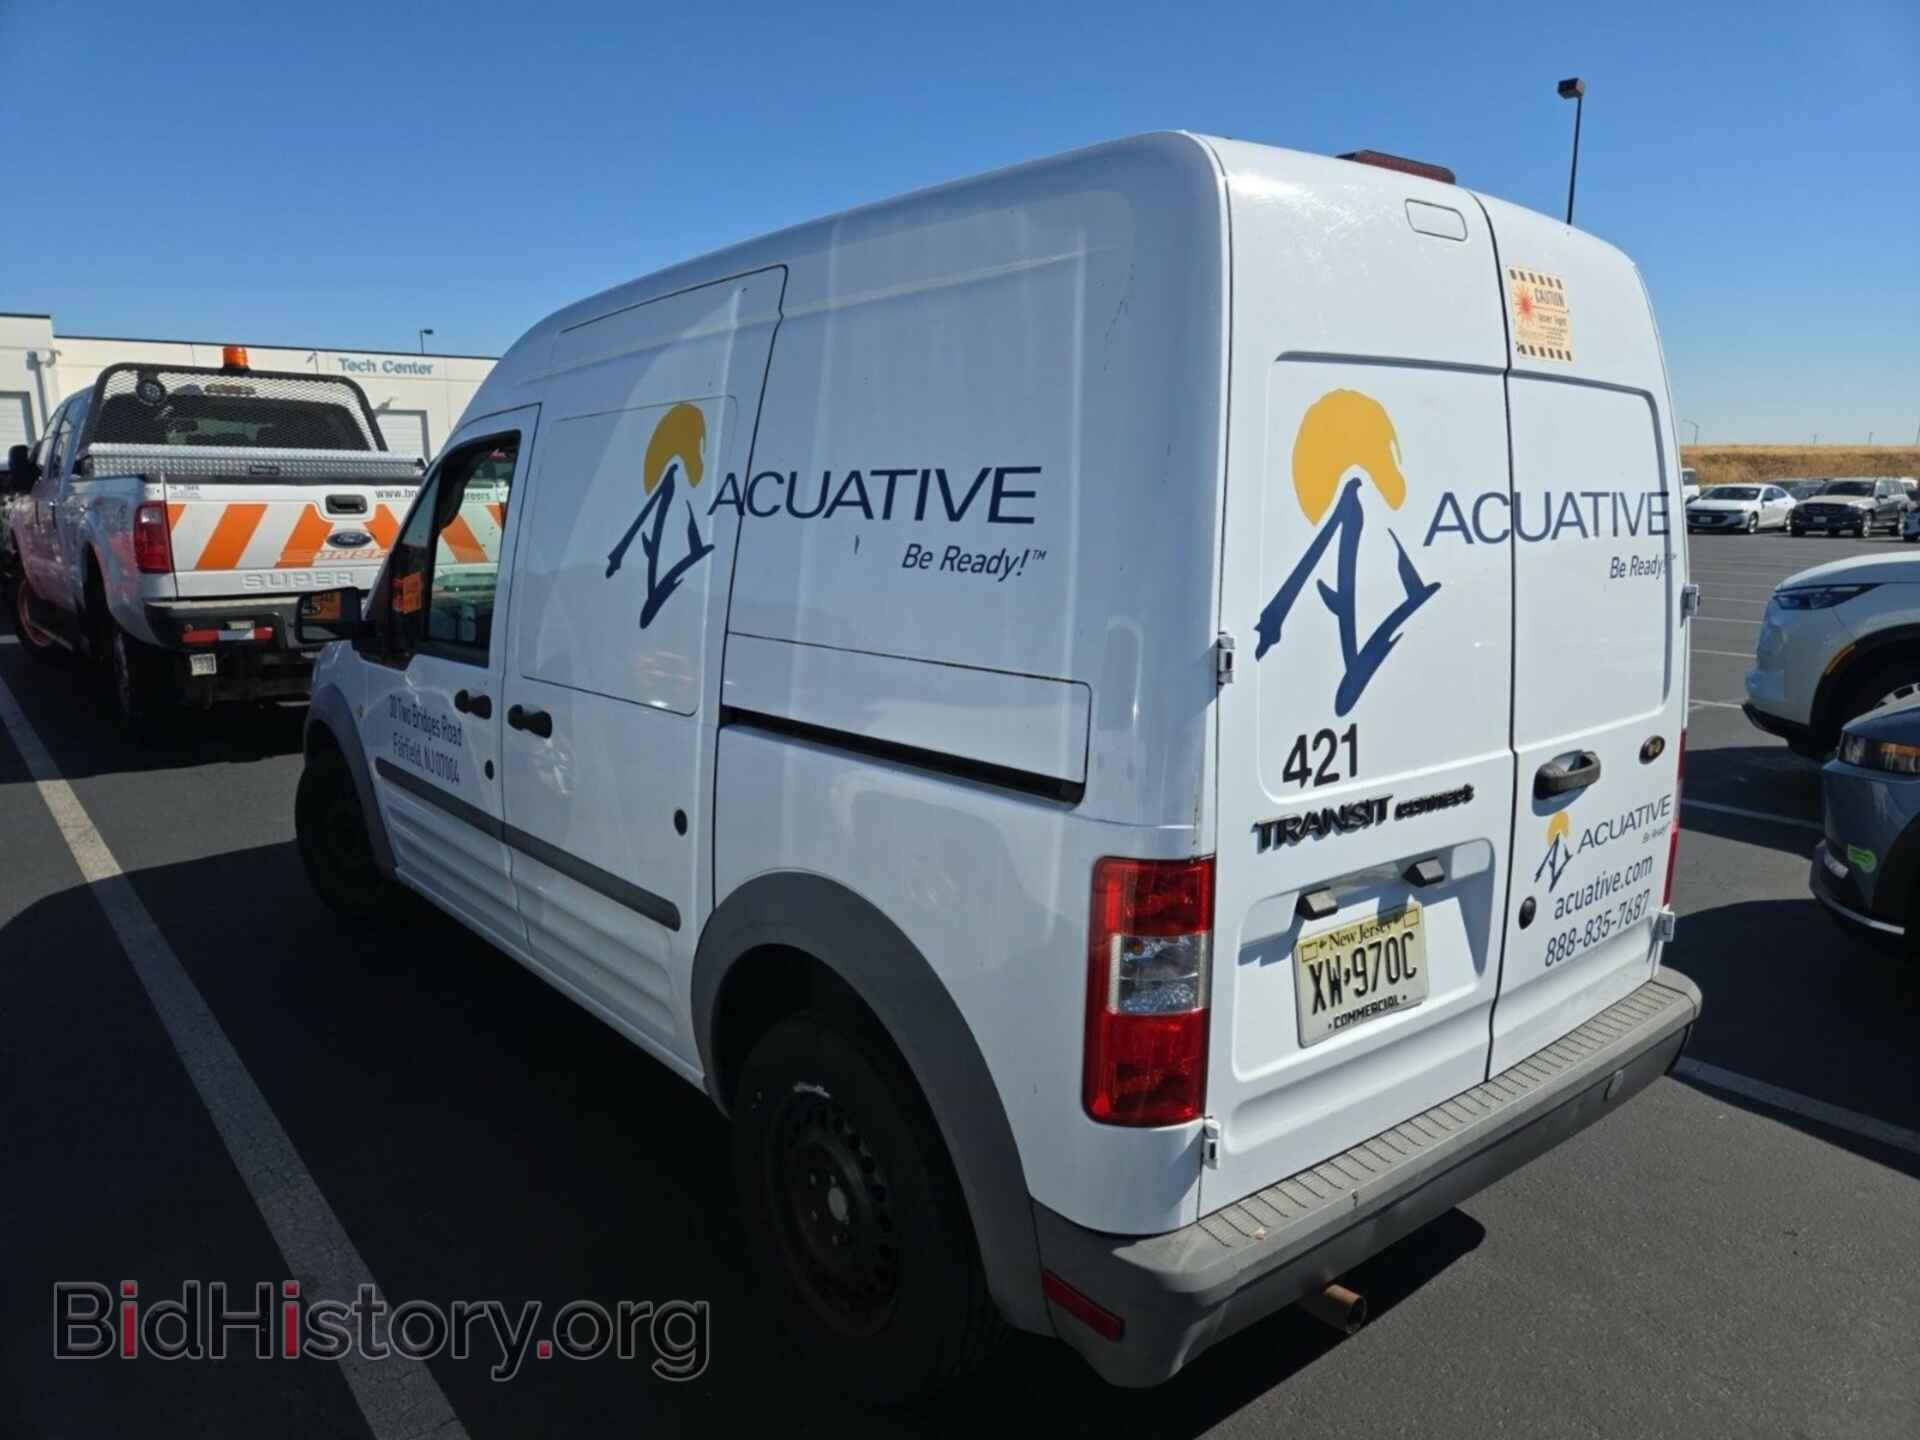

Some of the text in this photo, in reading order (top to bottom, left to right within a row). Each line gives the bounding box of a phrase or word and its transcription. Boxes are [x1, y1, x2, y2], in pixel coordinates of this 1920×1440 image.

[338, 357, 433, 375] Tech Center
[706, 466, 1042, 525] ACUATIVE
[1422, 491, 1670, 547] ACUATIVE
[241, 571, 354, 591] SUPER
[901, 543, 933, 570] Be
[1609, 556, 1627, 579] Be
[412, 704, 441, 741] Bridges
[440, 714, 462, 748] Road
[1282, 723, 1358, 788] 421
[1252, 794, 1394, 851] TRANSIT
[1577, 794, 1672, 854] ACUATIVE
[1554, 856, 1654, 920] acuative.com
[1328, 932, 1355, 951] New
[1544, 888, 1651, 968] 888-835-7687
[1333, 995, 1400, 1030] COMMERCIAL
